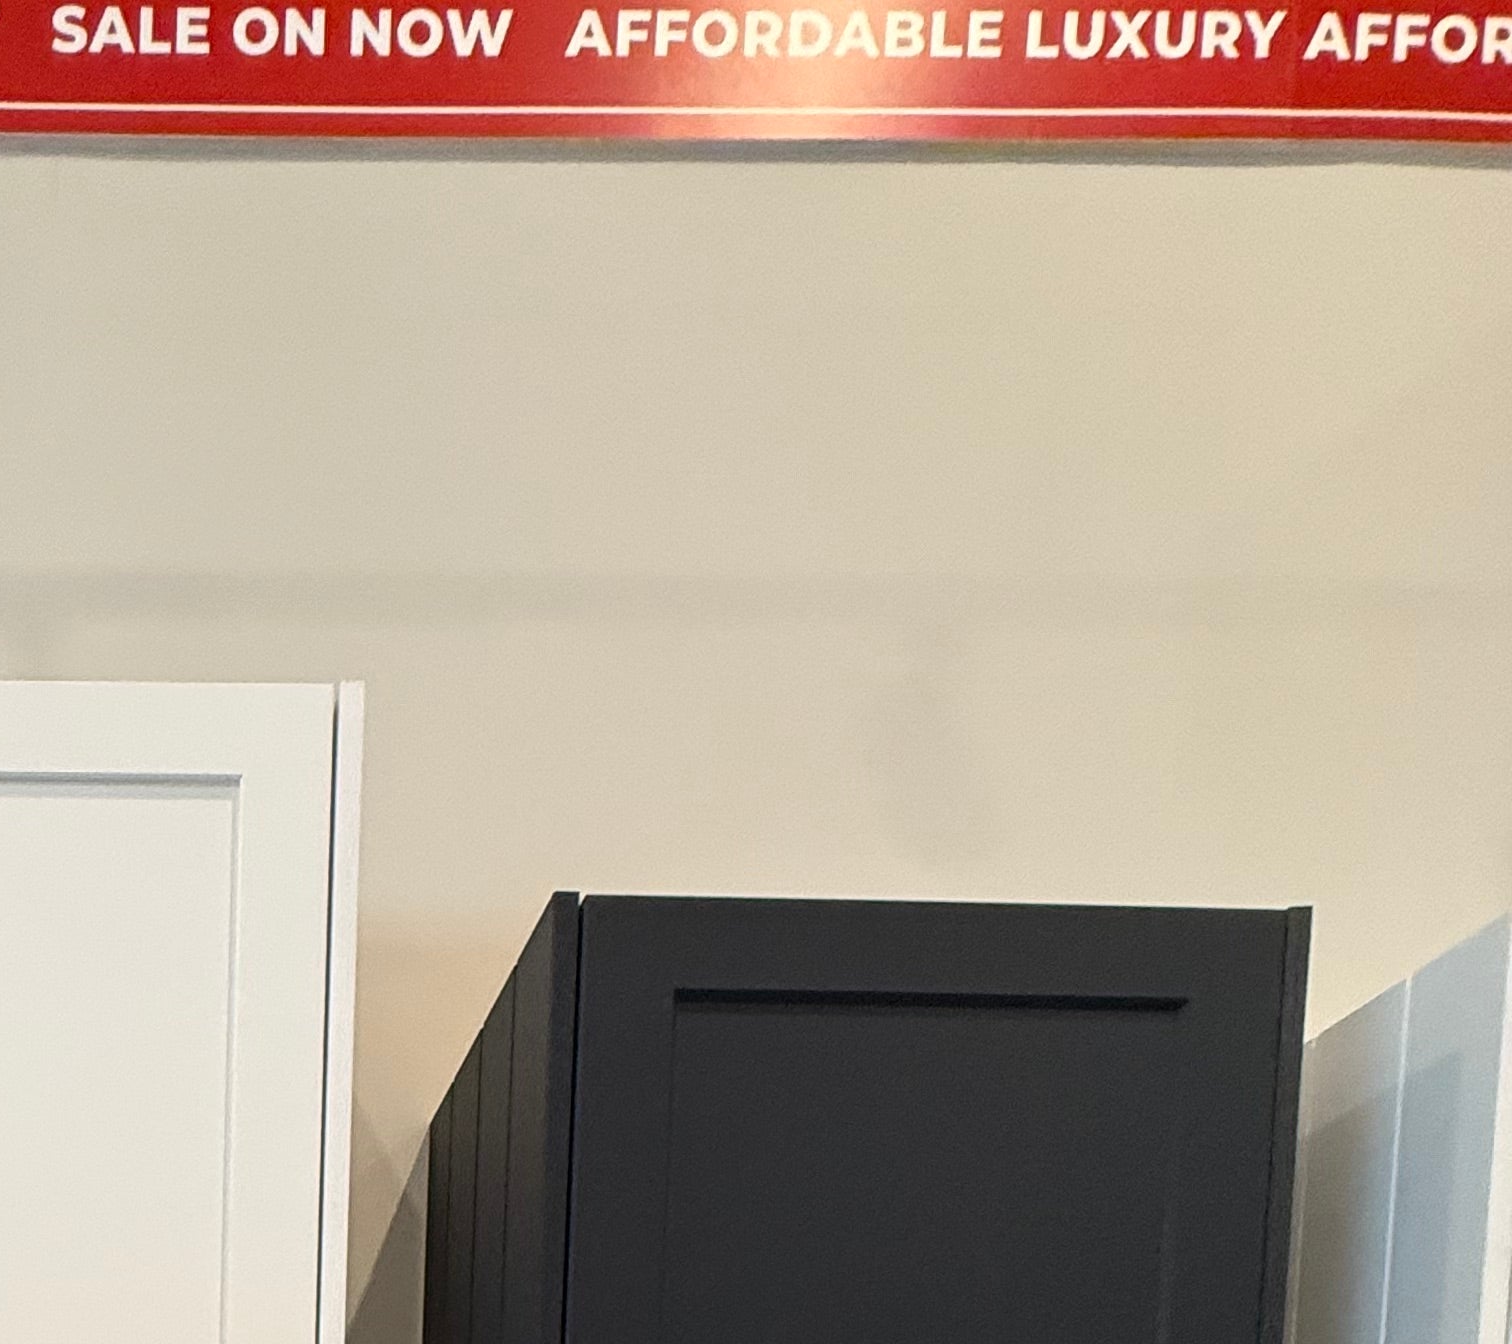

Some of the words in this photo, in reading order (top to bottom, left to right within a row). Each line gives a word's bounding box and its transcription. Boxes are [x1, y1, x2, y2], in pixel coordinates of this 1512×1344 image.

[51, 5, 211, 55] SALE
[232, 6, 325, 56] ON
[349, 7, 514, 57] NOW
[565, 8, 1004, 58] AFFORDABLE
[1025, 9, 1287, 59] LUXURY
[1302, 12, 1512, 63] AFFOR
